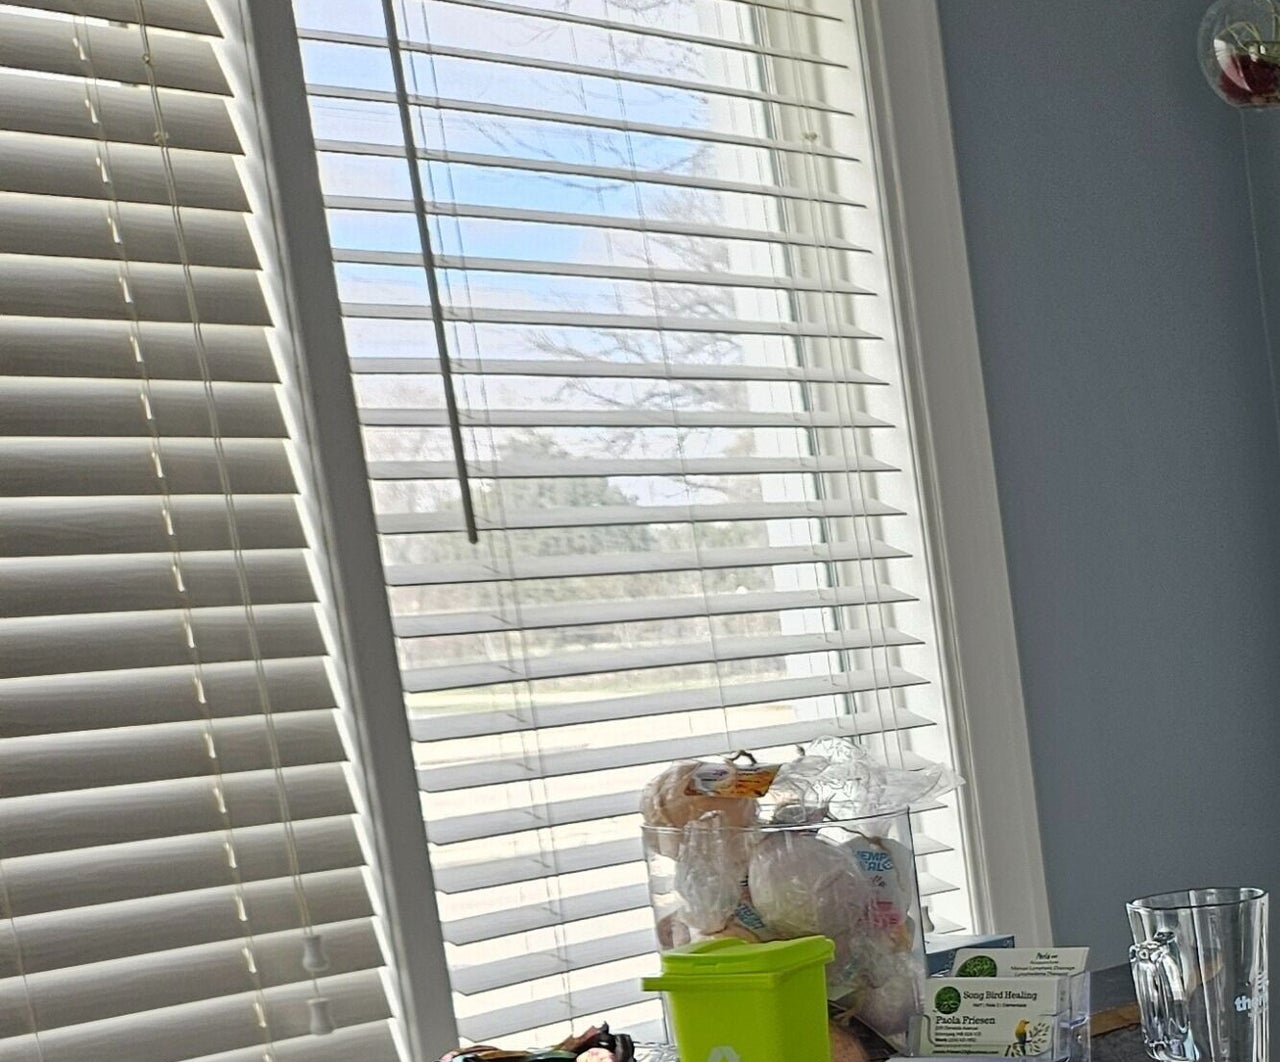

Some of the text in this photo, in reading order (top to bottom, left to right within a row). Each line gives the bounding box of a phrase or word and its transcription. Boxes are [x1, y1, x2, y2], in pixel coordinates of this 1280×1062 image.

[963, 990, 1038, 1001] Song Bird Healing
[936, 1015, 996, 1024] Paola Friesen
